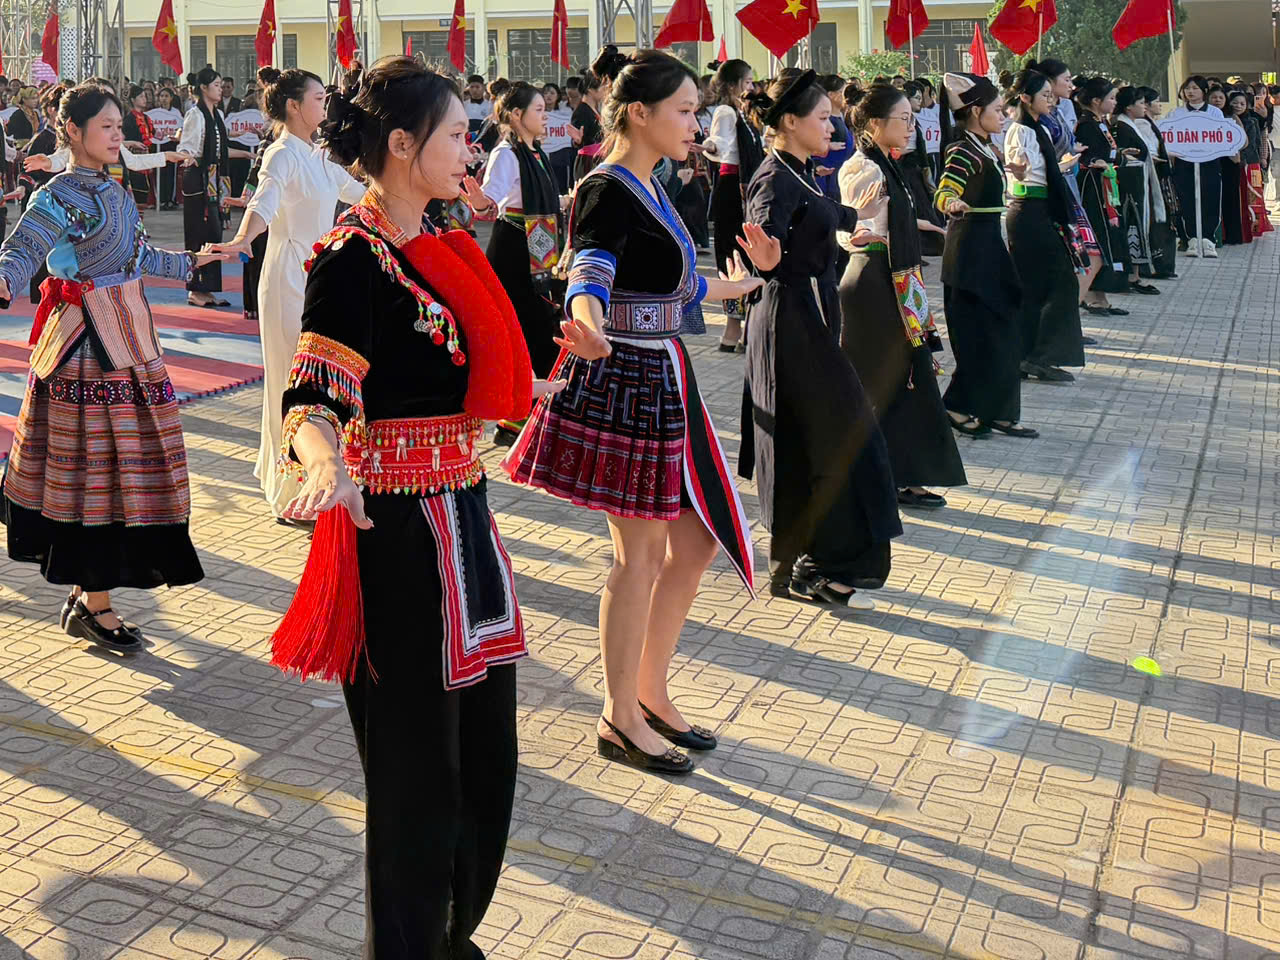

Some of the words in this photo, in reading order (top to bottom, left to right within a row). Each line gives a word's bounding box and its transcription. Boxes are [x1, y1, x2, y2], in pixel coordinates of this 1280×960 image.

[1177, 128, 1199, 143] DÂN
[1202, 126, 1223, 143] PHỐ
[1226, 131, 1233, 143] 9
